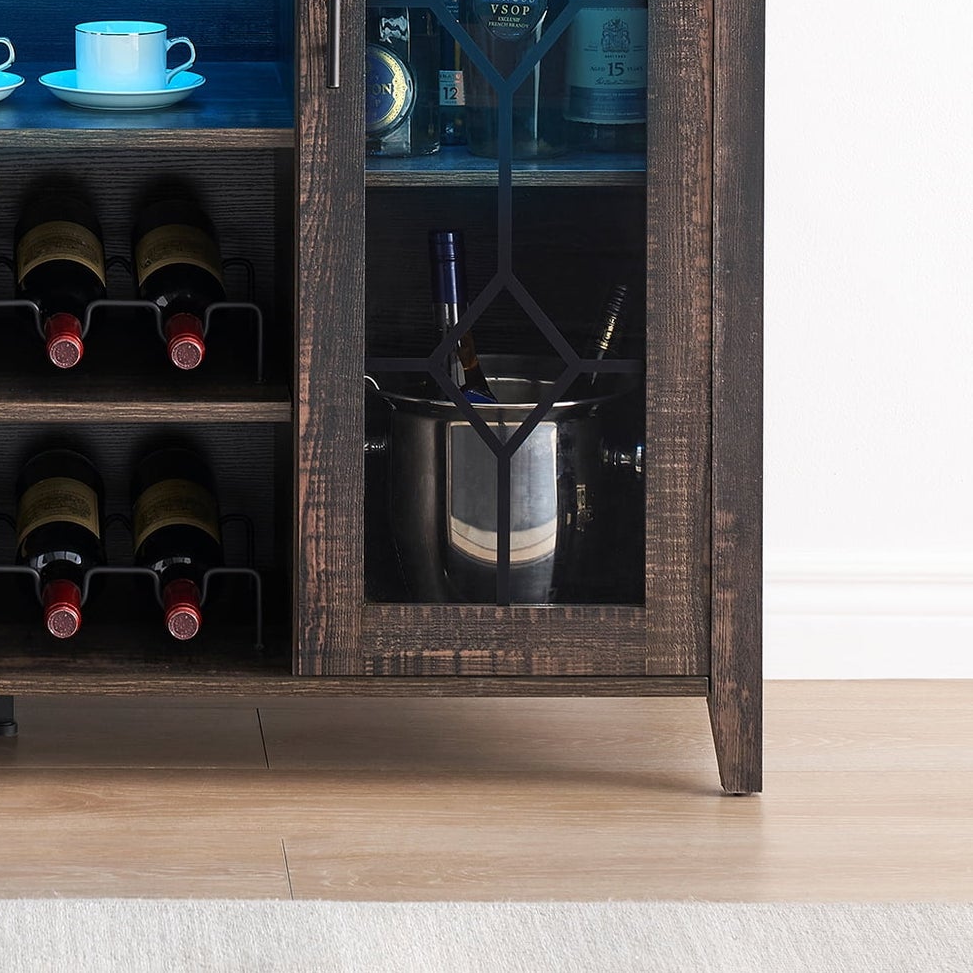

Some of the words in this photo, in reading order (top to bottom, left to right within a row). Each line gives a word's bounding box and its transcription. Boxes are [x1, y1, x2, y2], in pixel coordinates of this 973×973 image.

[490, 3, 530, 16] VSOP
[607, 62, 625, 76] 15
[443, 86, 458, 100] 12
